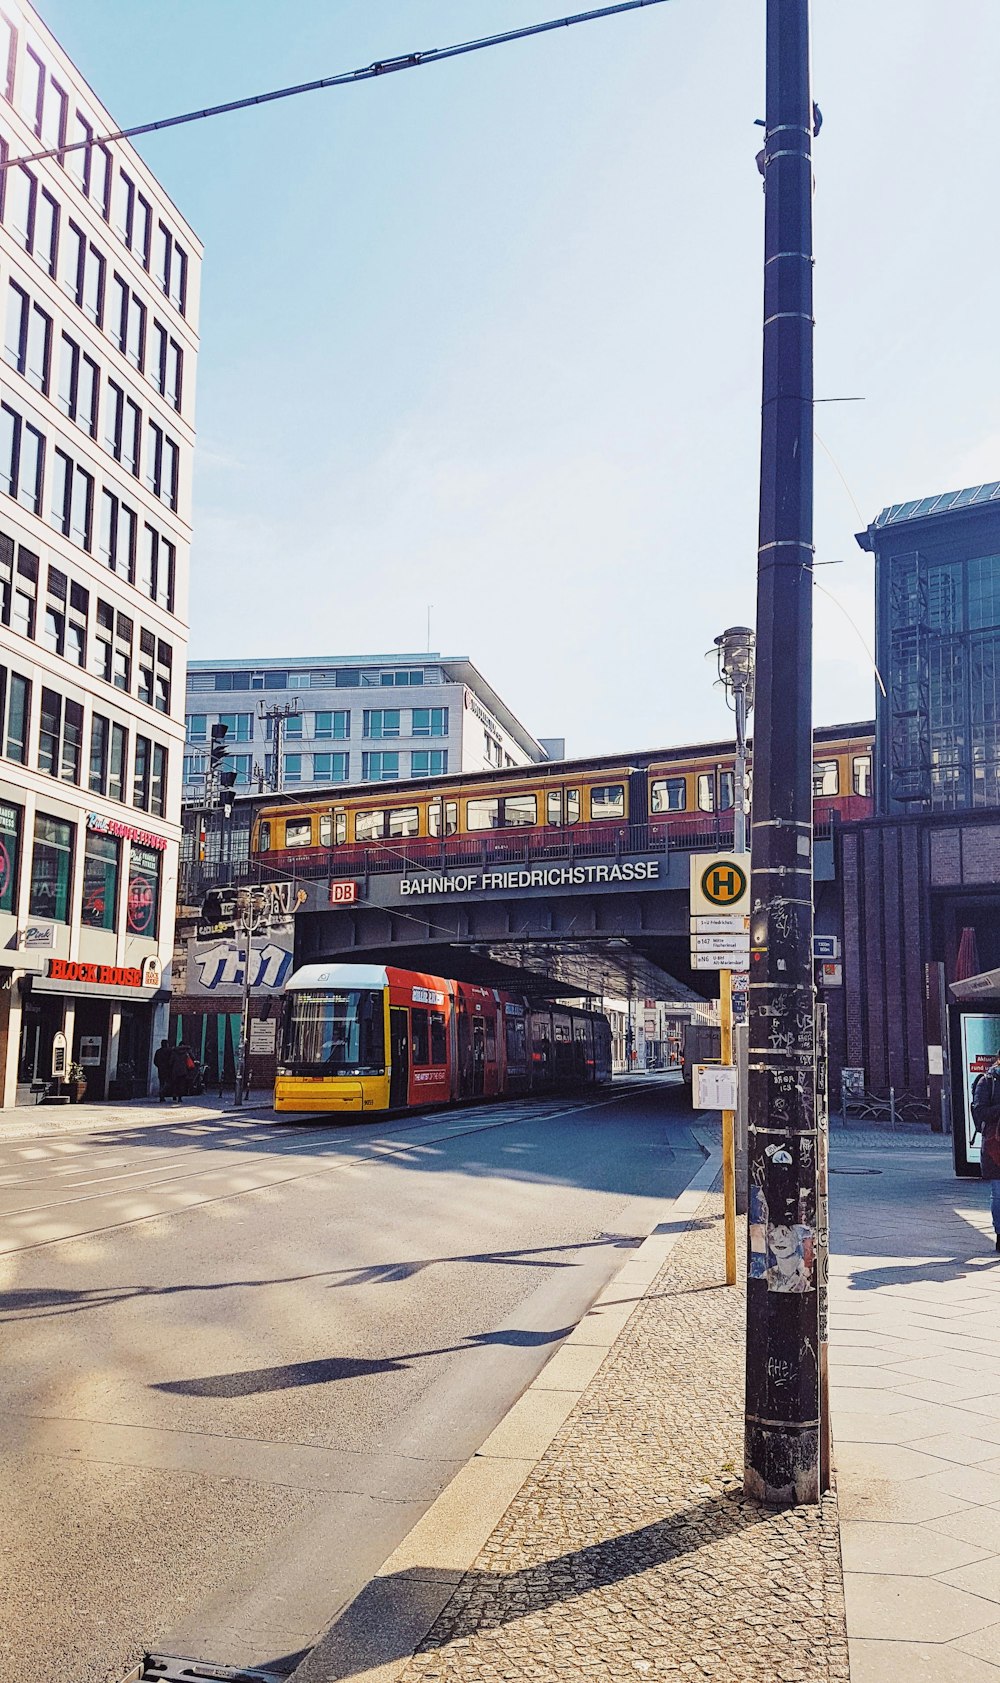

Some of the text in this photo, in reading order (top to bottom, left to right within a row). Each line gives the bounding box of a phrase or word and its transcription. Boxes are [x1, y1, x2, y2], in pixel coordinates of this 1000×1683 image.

[400, 861, 659, 895] BAHNHOF FRIEDRICHSTRASSE
[713, 871, 734, 896] H
[335, 885, 353, 901] DB
[26, 927, 51, 940] Pink
[50, 958, 142, 988] BLOCK HOUSE
